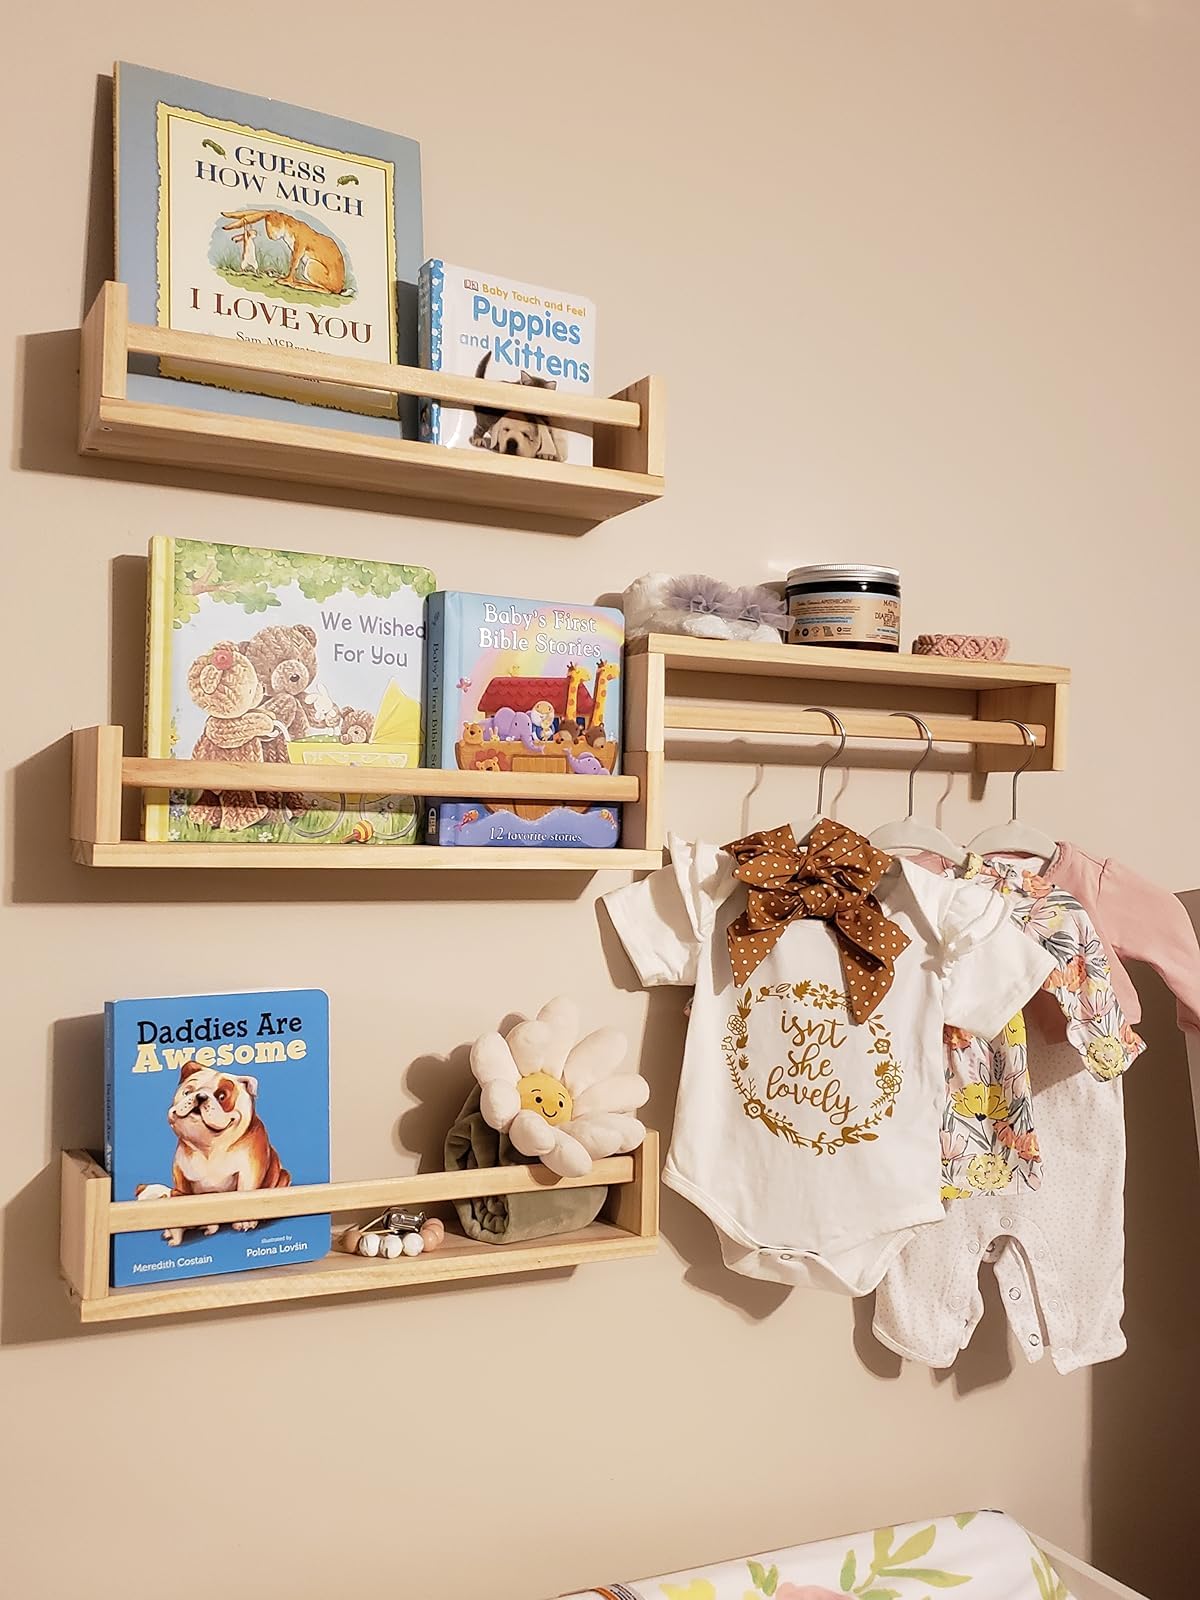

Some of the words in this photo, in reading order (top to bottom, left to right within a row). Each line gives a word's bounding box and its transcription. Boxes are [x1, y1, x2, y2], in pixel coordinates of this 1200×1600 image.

[235, 146, 326, 184] GUESS
[195, 159, 267, 193] HOW
[276, 182, 364, 217] MUCH
[190, 287, 201, 310] I
[212, 292, 300, 330] LOVE
[306, 312, 372, 344] YOU
[482, 283, 509, 300] Baby
[512, 291, 541, 306] Touch
[544, 300, 563, 312] and
[566, 304, 586, 317] Feel
[473, 295, 581, 345] Puppies
[459, 332, 489, 349] and
[494, 336, 590, 384] Kittens
[321, 611, 352, 631] We
[359, 614, 426, 641] Wished
[484, 602, 546, 629] Baby's
[553, 609, 597, 633] First
[333, 643, 365, 663] For
[371, 646, 408, 667] You
[479, 626, 529, 651] Bible
[535, 634, 601, 658] Stories
[490, 827, 504, 840] 12
[507, 831, 547, 841] favorite
[550, 832, 582, 842] stories
[137, 1017, 248, 1045] Daddies
[256, 1012, 302, 1036] Are
[780, 1010, 848, 1049] isnt
[132, 1038, 307, 1073] Awesome
[787, 1042, 834, 1081] she
[766, 1065, 858, 1125] lovely
[132, 1258, 175, 1273] Meredith
[177, 1254, 213, 1268] Costain
[246, 1246, 277, 1258] Polona
